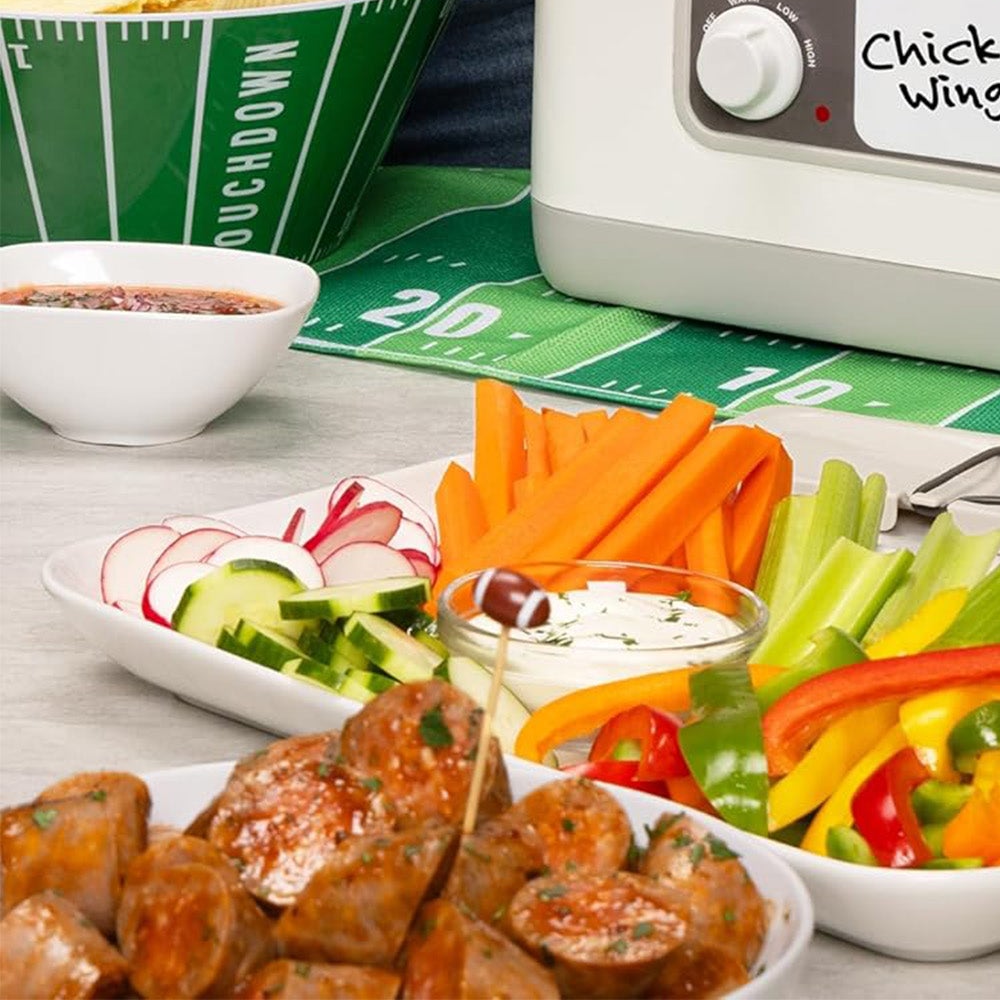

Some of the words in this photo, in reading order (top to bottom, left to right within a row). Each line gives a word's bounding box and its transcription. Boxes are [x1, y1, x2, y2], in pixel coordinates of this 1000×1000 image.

[702, 12, 717, 33] OFF
[775, 2, 799, 23] LOW
[803, 39, 816, 68] HIGH
[213, 40, 299, 248] OUCHDOWN
[357, 288, 503, 339] 20
[716, 365, 854, 406] 10
